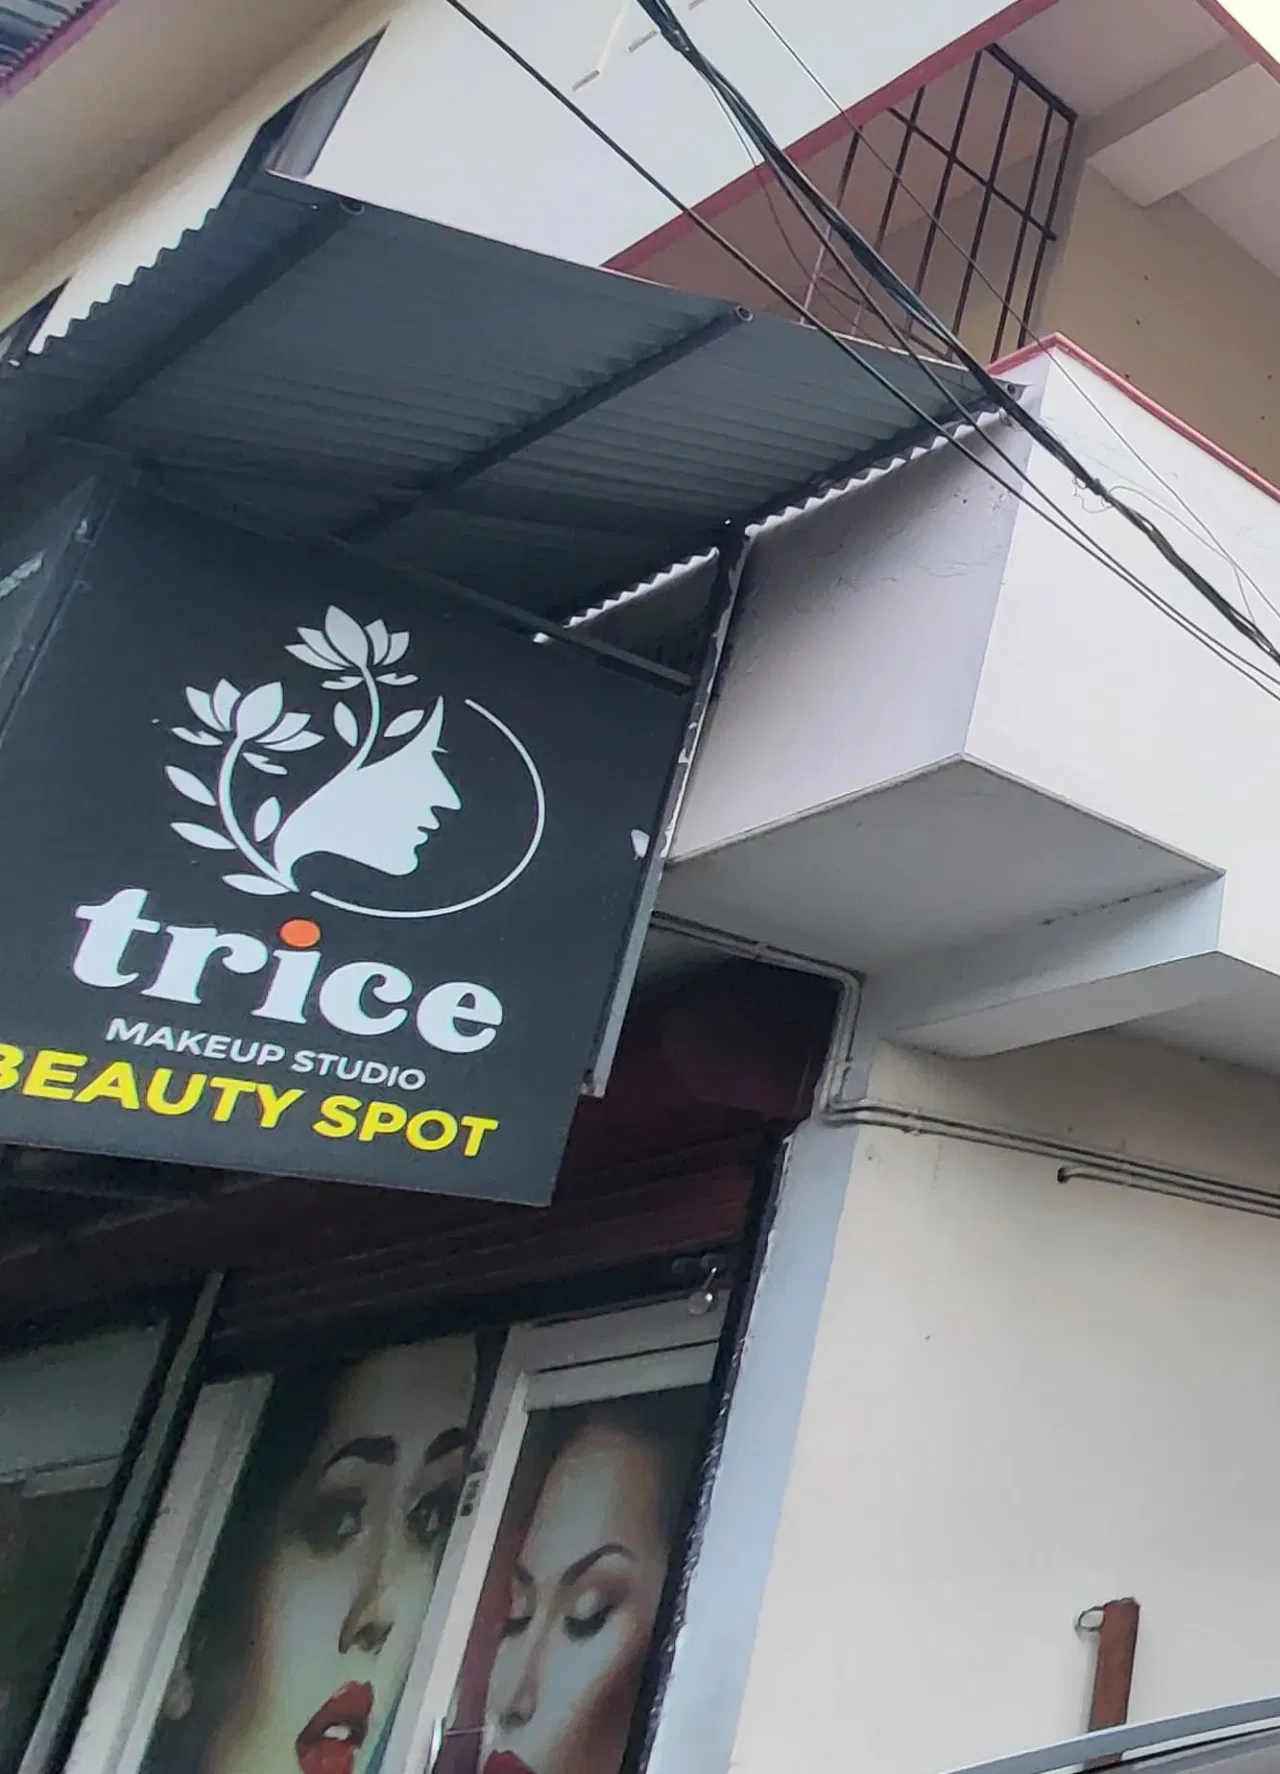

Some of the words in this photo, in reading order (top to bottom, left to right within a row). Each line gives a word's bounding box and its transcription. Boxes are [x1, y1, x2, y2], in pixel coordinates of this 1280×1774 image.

[72, 888, 504, 1054] trice
[0, 1042, 305, 1130] BEAUTY
[312, 1094, 499, 1158] SPOT
[106, 1016, 286, 1067] MAKEUP
[292, 1049, 427, 1091] STUDIO
